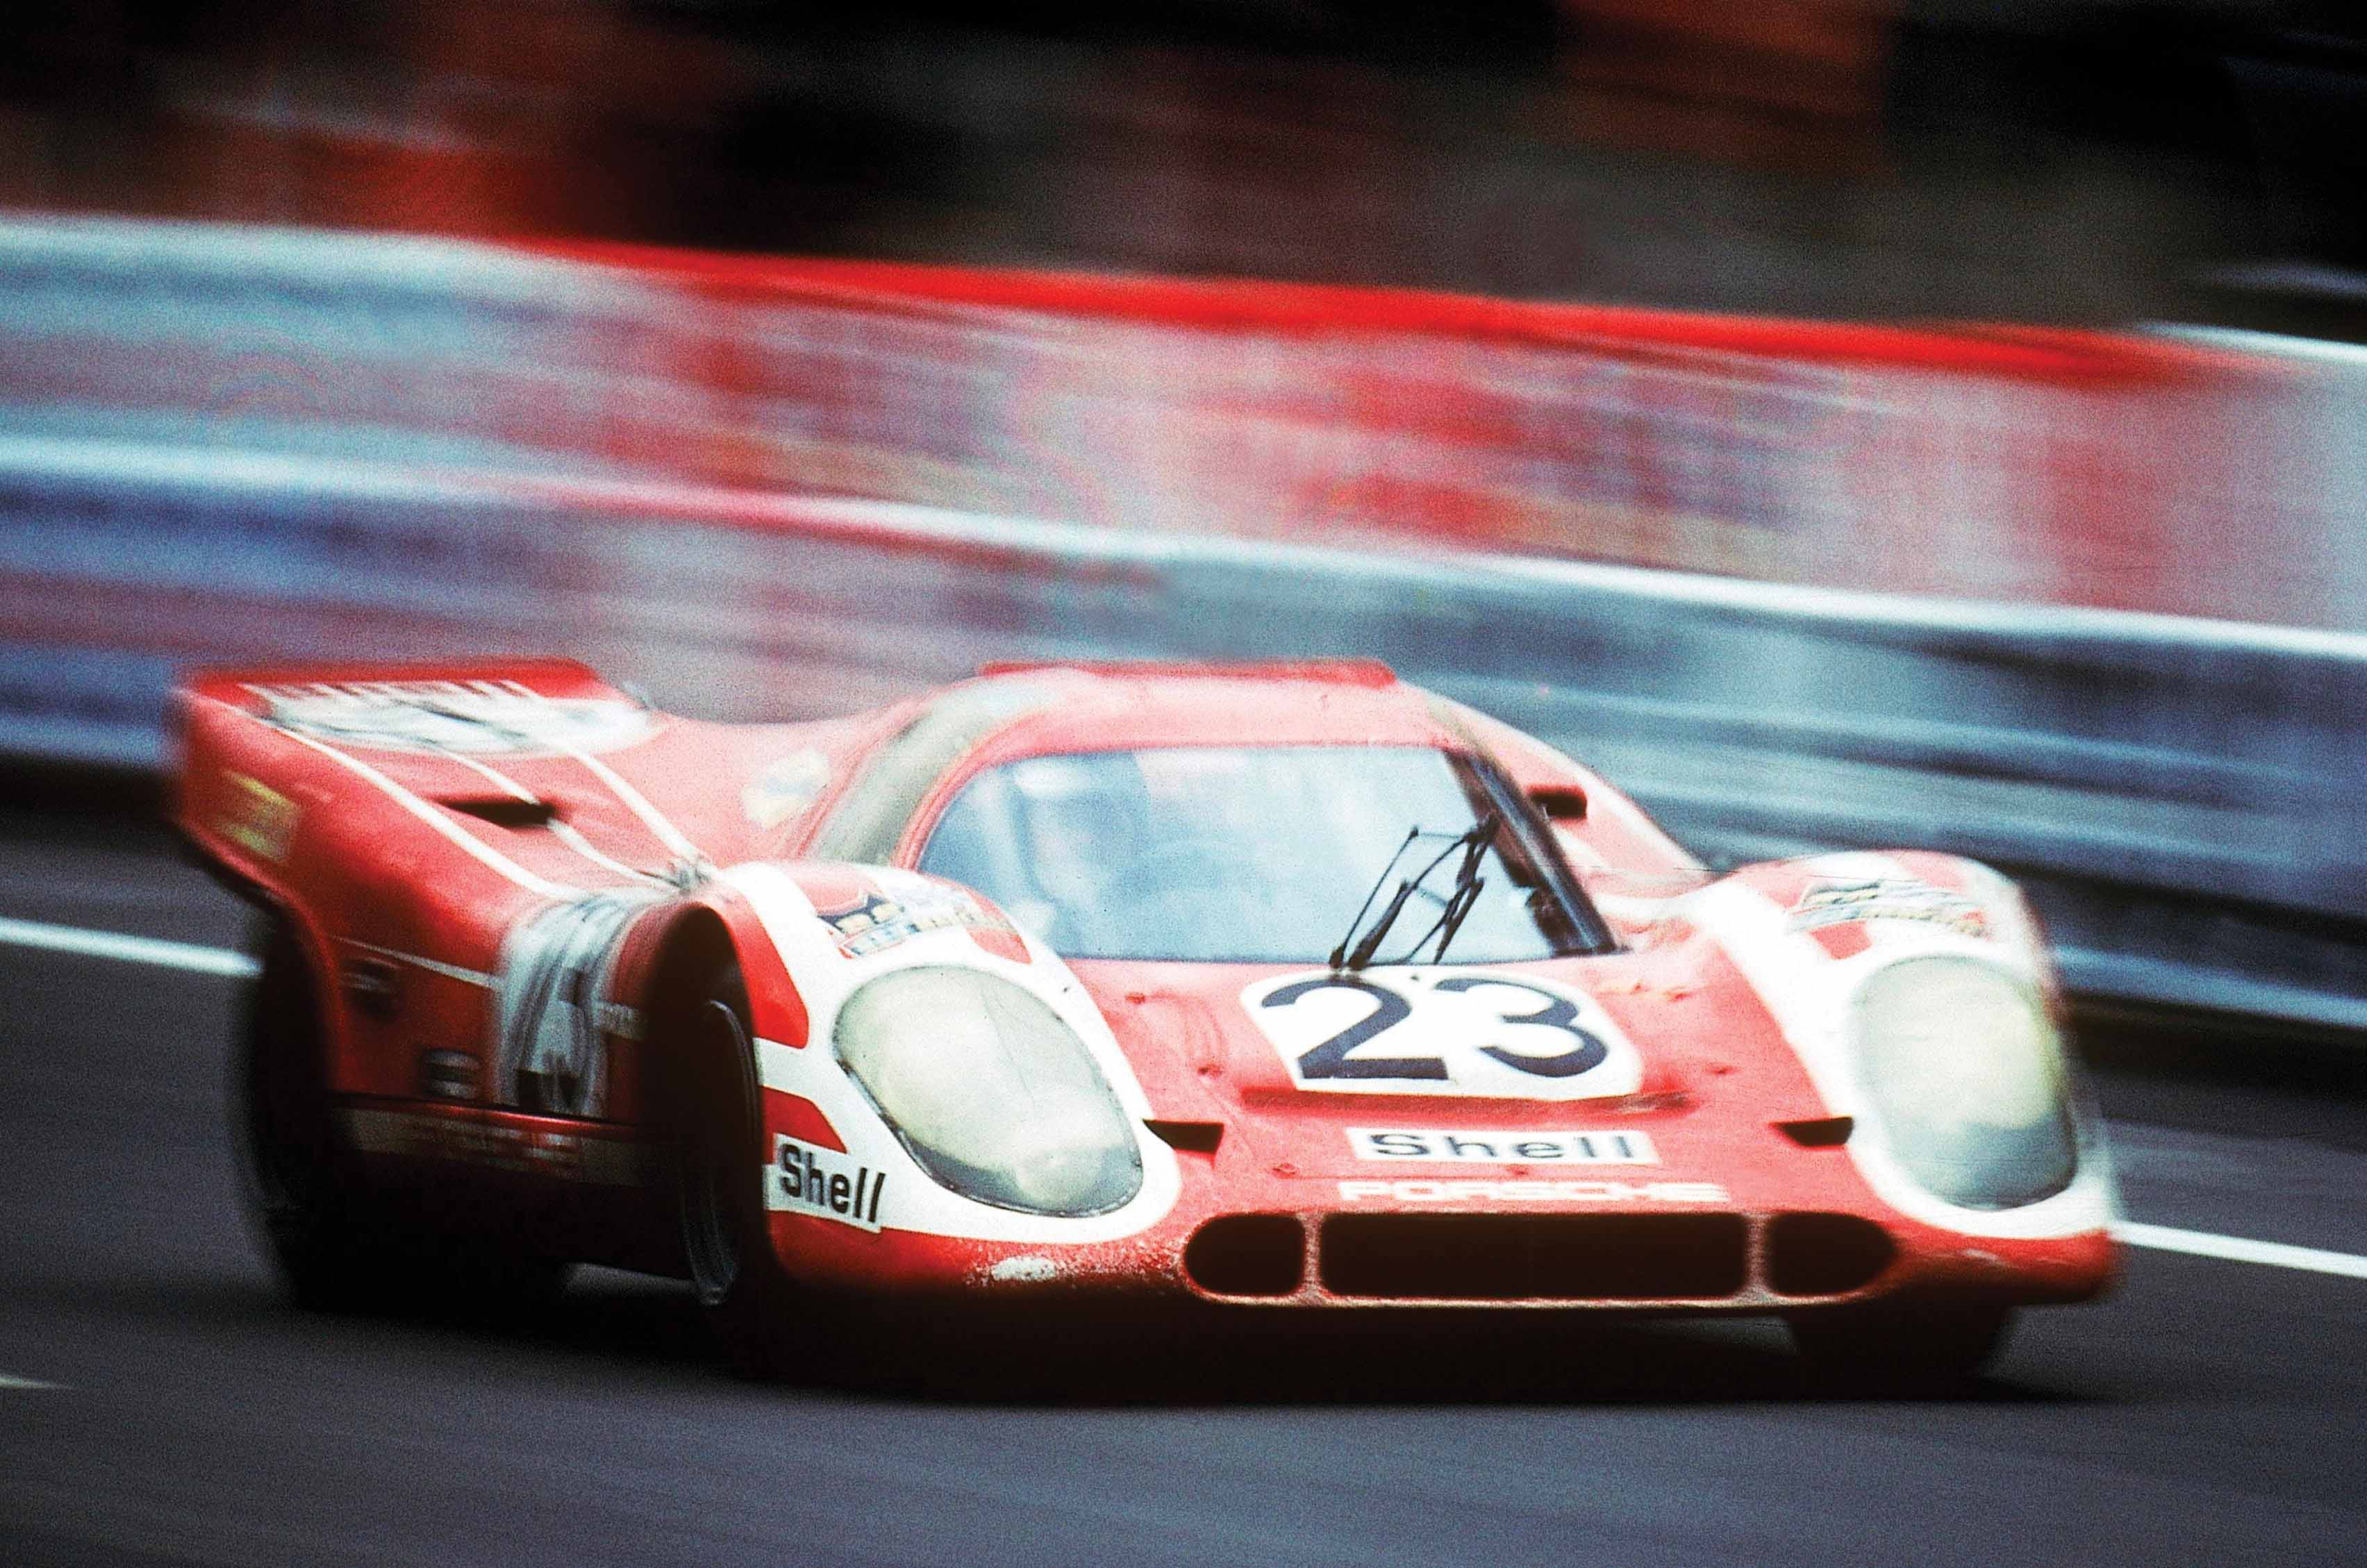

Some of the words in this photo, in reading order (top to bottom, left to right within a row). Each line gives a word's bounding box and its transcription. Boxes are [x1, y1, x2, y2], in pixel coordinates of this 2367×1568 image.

[1261, 975, 1609, 1081] 23
[1368, 1132, 1638, 1160] Shell
[779, 1143, 886, 1223] Shell
[1337, 1181, 1730, 1203] PORSCHE
